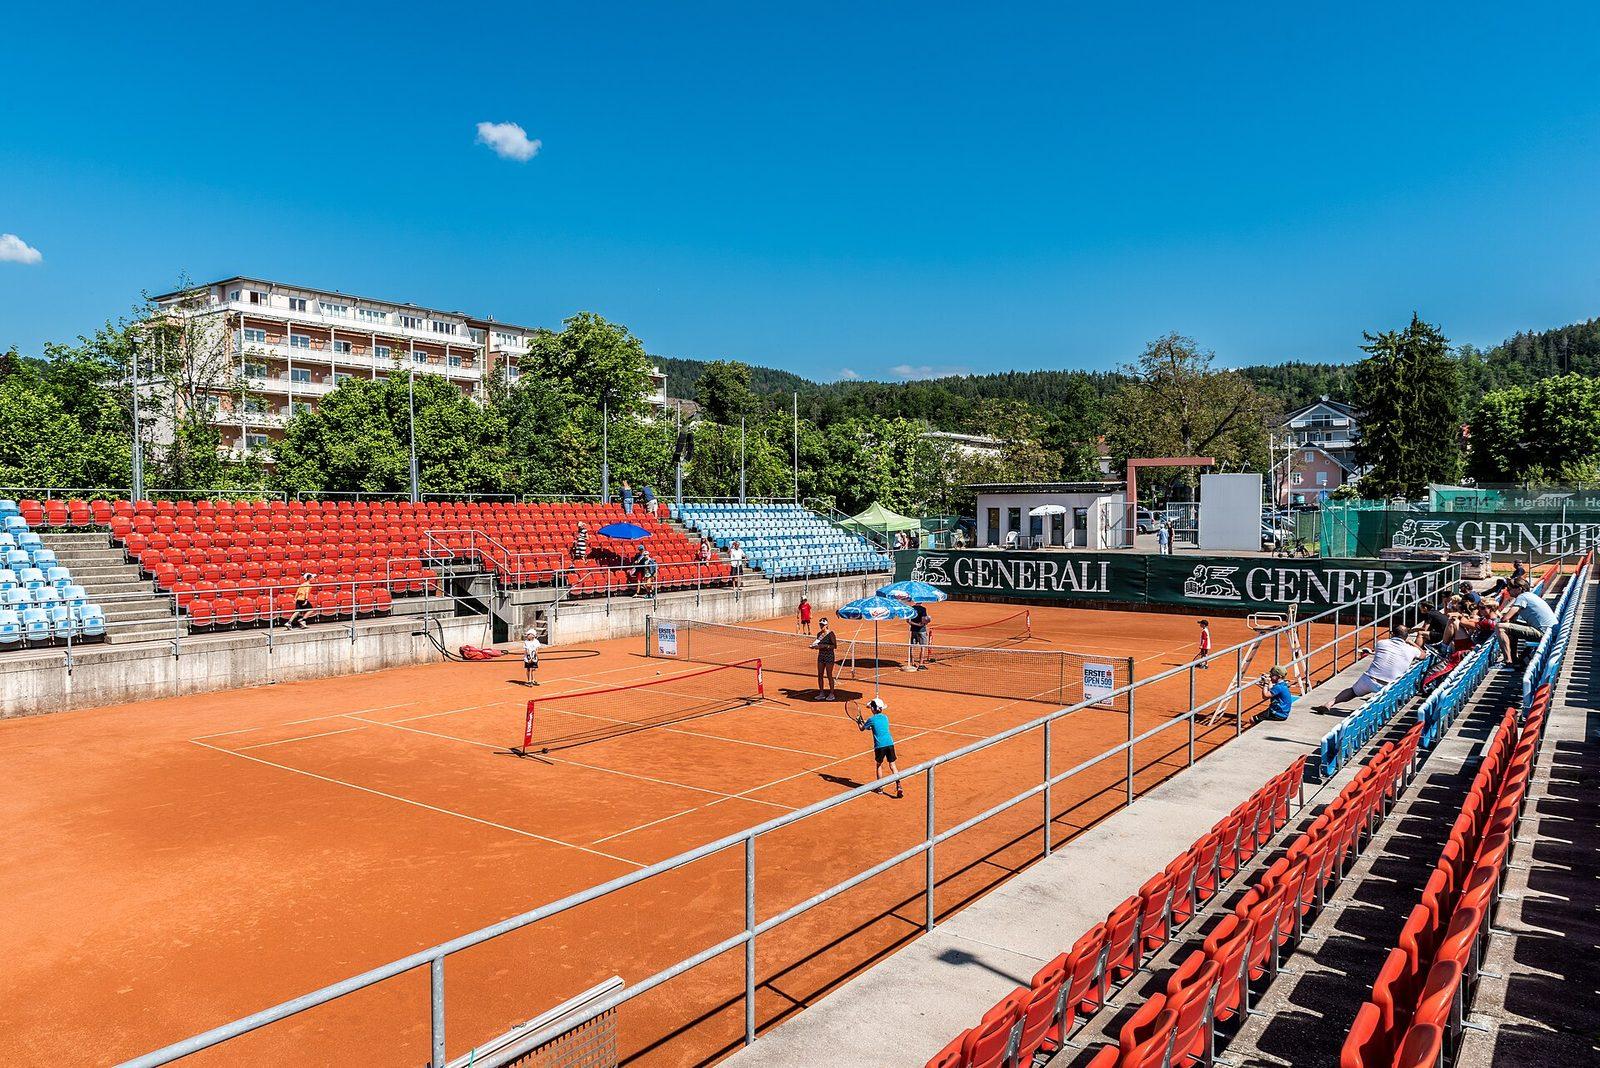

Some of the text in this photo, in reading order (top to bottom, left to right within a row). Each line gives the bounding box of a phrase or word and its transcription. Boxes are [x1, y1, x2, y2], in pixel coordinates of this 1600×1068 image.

[1514, 497, 1574, 507] Heraklih
[953, 557, 1111, 593] GENERALI
[1084, 669, 1105, 677] ERSTE
[1084, 676, 1100, 684] OPEN
